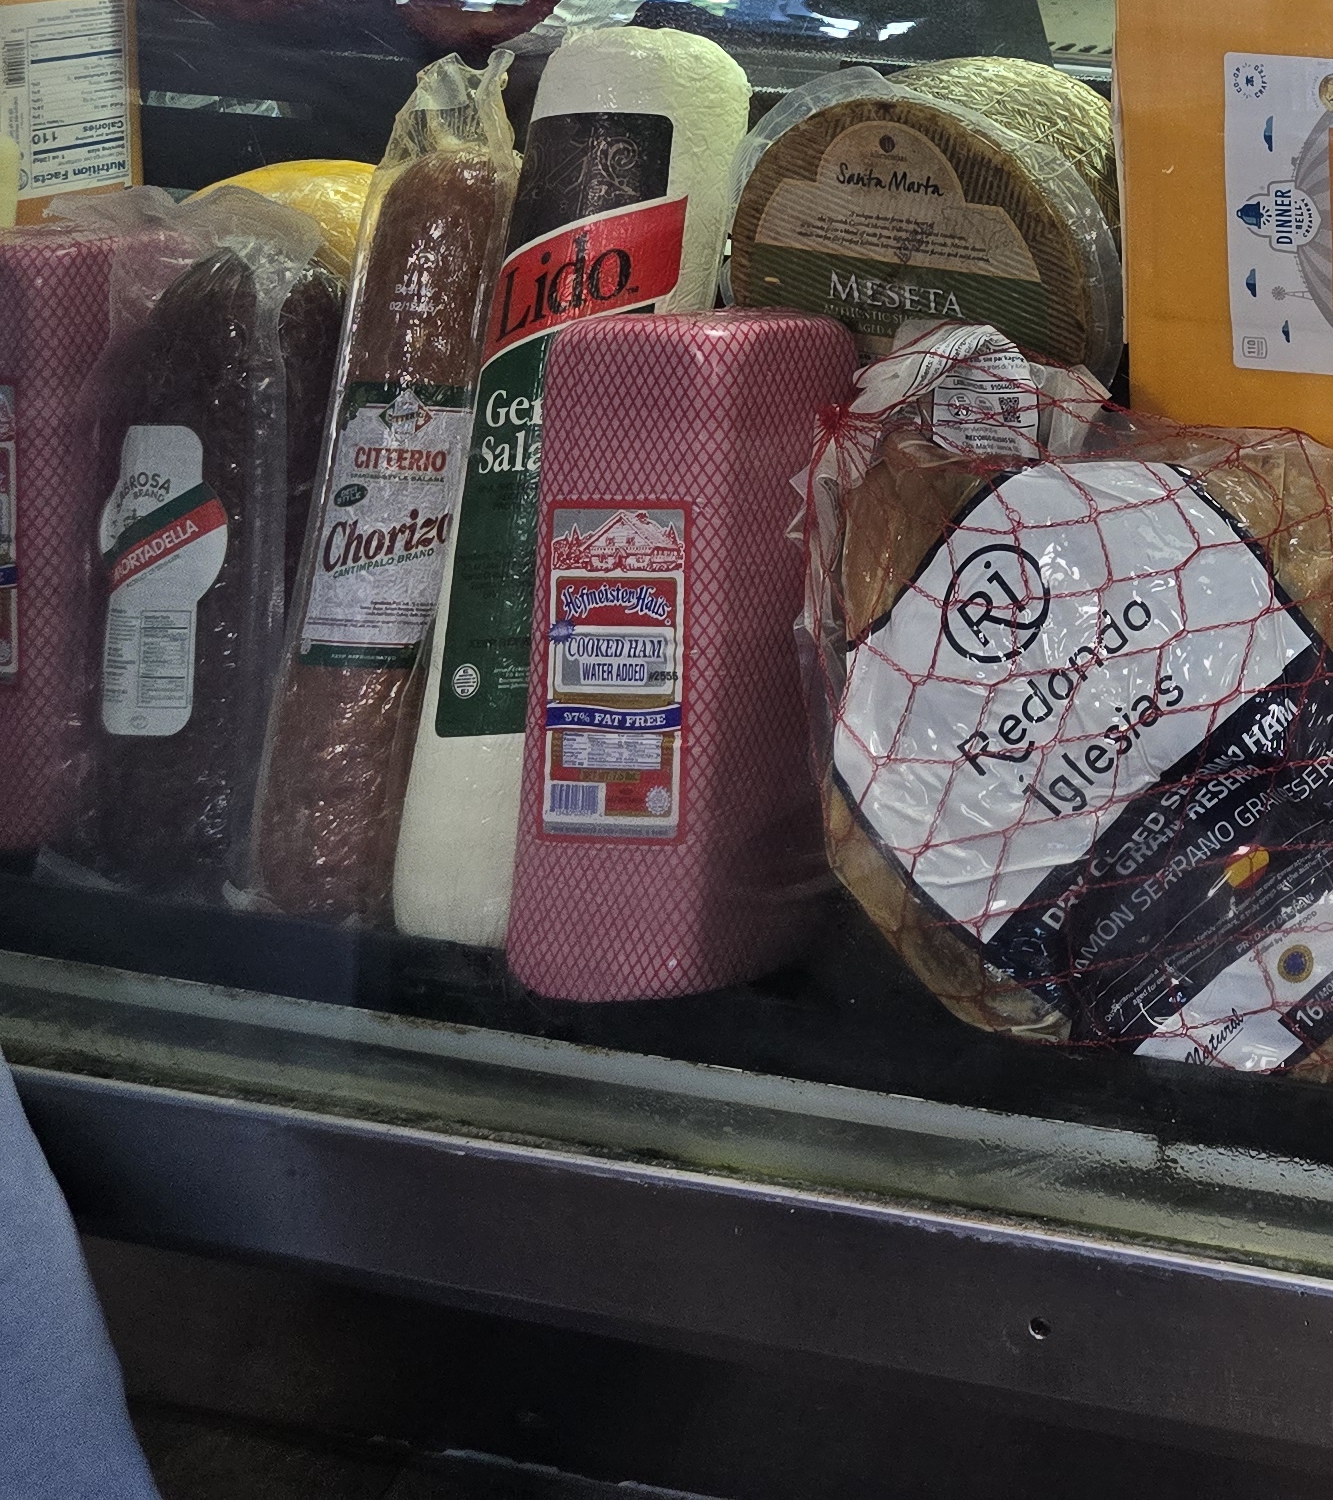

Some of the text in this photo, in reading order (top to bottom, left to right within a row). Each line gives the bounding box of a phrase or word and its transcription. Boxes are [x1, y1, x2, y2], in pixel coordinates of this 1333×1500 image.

[32, 120, 124, 145] Calories 110
[33, 160, 126, 183] Nutrition Facts
[836, 162, 944, 196] Santa Marta
[1275, 188, 1293, 245] DINNER
[499, 231, 633, 345] Lido
[827, 270, 965, 318] MESETA
[354, 446, 446, 472] CITTERIO
[332, 547, 435, 579] CANTIMPALO BRAND
[562, 583, 637, 619] Hofmeister
[567, 635, 665, 659] COOKED HAM
[582, 661, 645, 682] WATER ADDED
[956, 600, 1151, 777] Redondo
[563, 712, 666, 727] 97% FAT FREE
[1241, 698, 1299, 754] HAM
[1294, 999, 1324, 1028] 16
